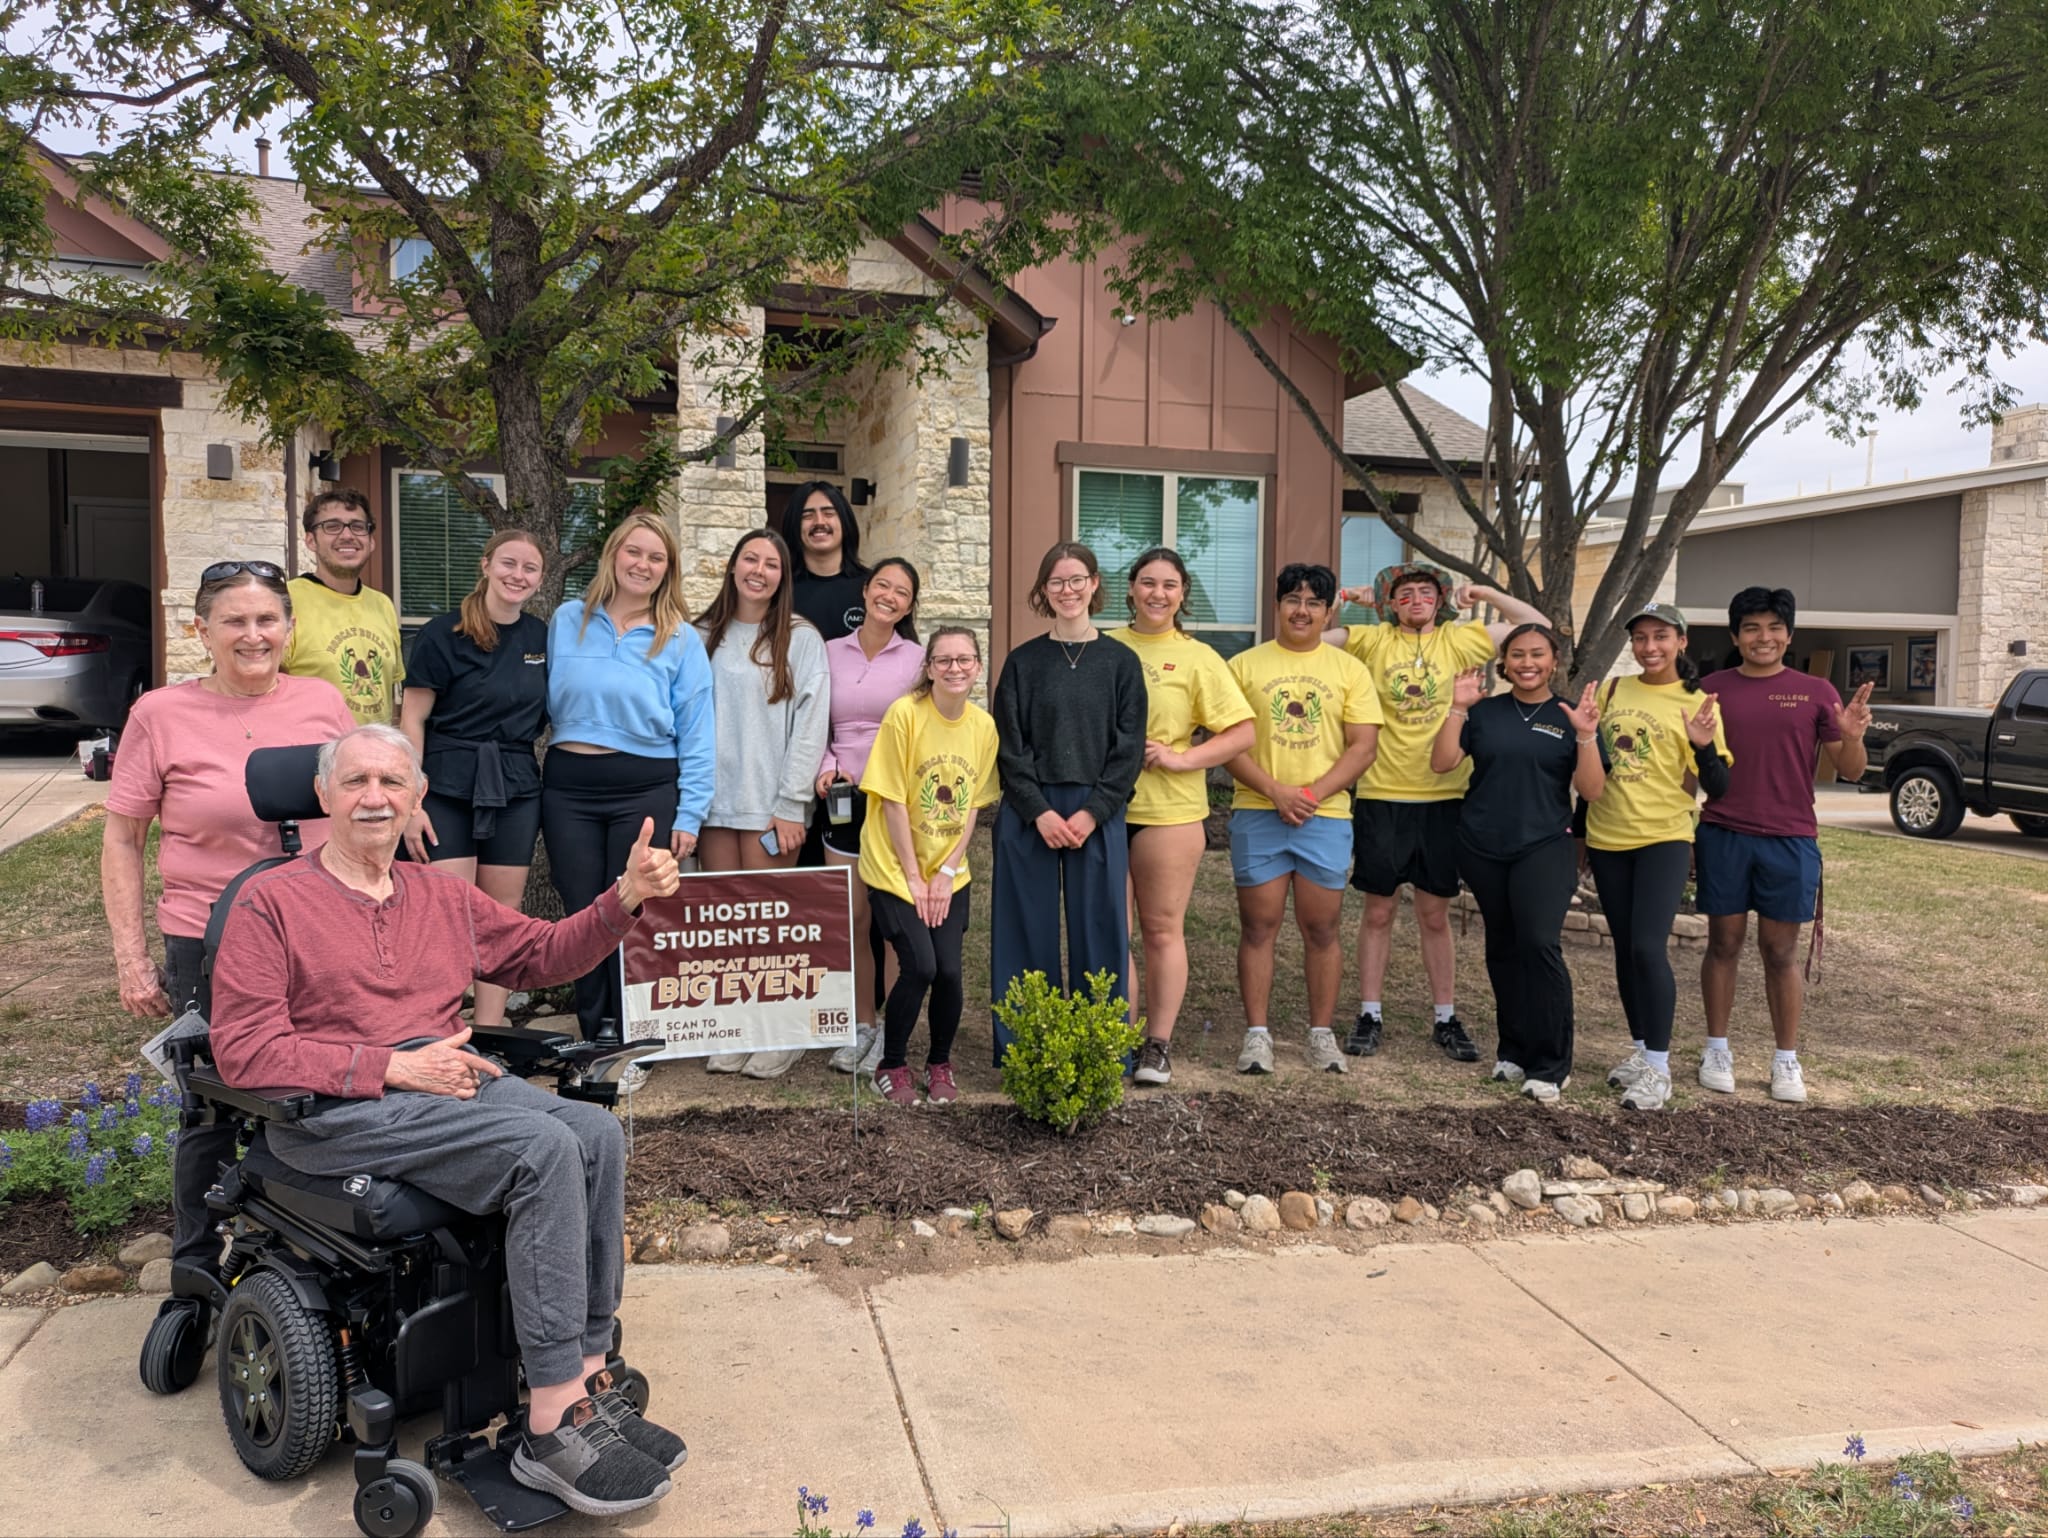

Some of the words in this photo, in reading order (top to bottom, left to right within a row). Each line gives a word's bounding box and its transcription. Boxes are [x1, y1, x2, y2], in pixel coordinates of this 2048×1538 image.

[326, 627, 358, 655] BOBCAT
[1768, 694, 1809, 702] COLLEGE
[684, 905, 692, 924] I
[699, 901, 790, 923] HOSTED
[653, 927, 771, 950] STUDENTS
[778, 924, 822, 943] FOR
[678, 957, 746, 976] BOBCAT
[749, 953, 810, 972] BUILD'S
[656, 974, 713, 1006] BIG
[720, 967, 829, 1001] EVENT
[666, 1020, 697, 1031] SCAN
[702, 1018, 717, 1029] TO
[818, 1011, 849, 1025] BIG
[667, 1031, 704, 1043] LEARN
[708, 1028, 742, 1040] MORE
[818, 1025, 849, 1034] EVENT
